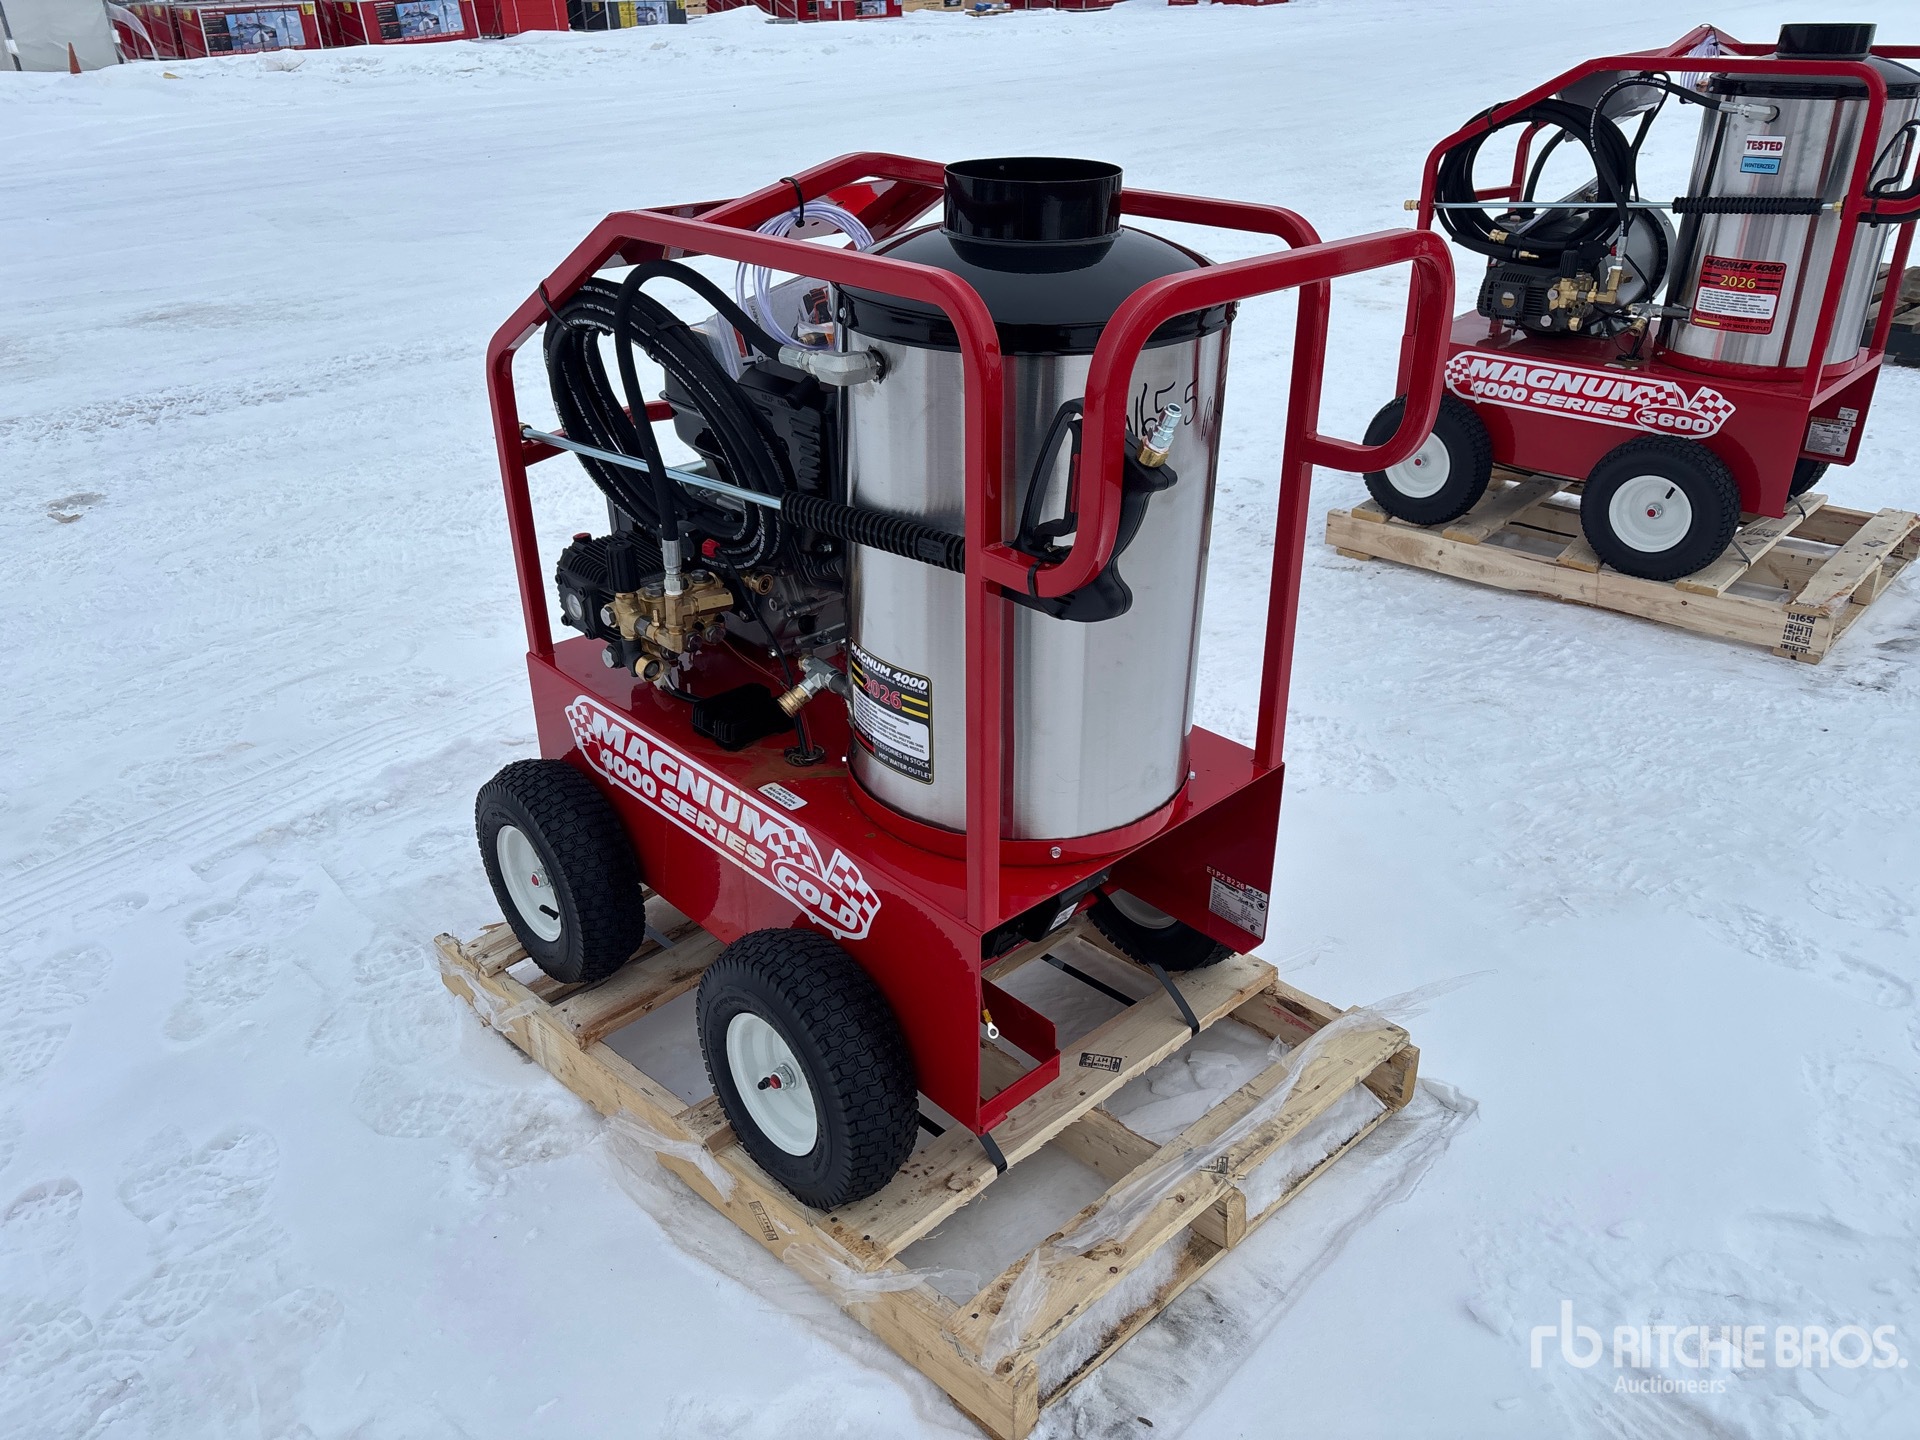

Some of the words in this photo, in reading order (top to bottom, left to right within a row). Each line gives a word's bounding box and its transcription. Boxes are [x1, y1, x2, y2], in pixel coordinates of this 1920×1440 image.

[1746, 140, 1783, 151] TESTED
[1744, 162, 1776, 170] WINTERIZED
[1705, 258, 1752, 270] MAGNUM
[1753, 264, 1784, 272] 4000
[1720, 275, 1756, 289] 2026
[1470, 358, 1643, 404] MAGNUM
[1470, 380, 1528, 402] 4000
[1529, 391, 1631, 418] SERIES
[1640, 409, 1711, 432] 3600
[851, 641, 891, 677] MAGNUM
[892, 672, 928, 690] 4000
[863, 673, 902, 710] 2026
[897, 682, 928, 696] WASHERS
[872, 738, 903, 759] ACCESSORIES
[903, 754, 909, 762] IN
[910, 757, 930, 769] STOCK
[878, 752, 889, 761] HOT
[889, 758, 908, 771] WATER
[908, 766, 932, 780] OUTLET
[592, 710, 780, 844] MAGNUM
[600, 747, 657, 798] 4000
[660, 788, 768, 869] SERIES
[777, 866, 858, 930] GOLD
